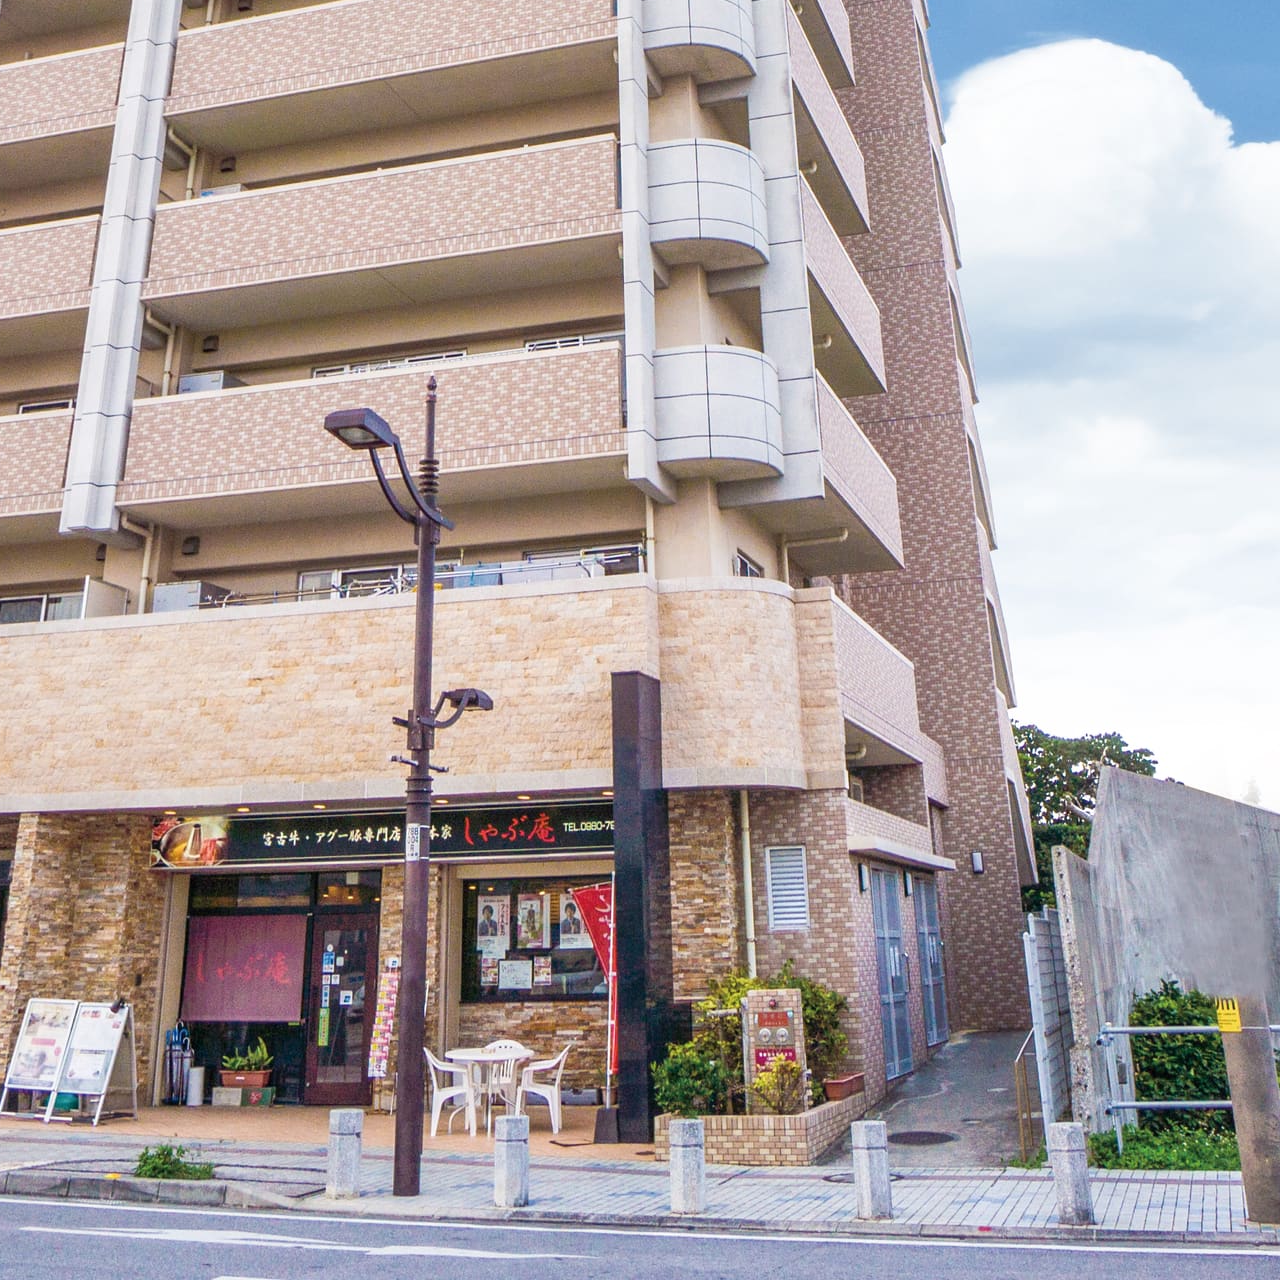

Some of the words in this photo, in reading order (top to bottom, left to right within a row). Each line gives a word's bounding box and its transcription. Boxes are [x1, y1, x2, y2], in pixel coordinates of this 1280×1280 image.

[463, 813, 556, 846] しゃぶ庵
[197, 951, 293, 985] しゃぶ庵
